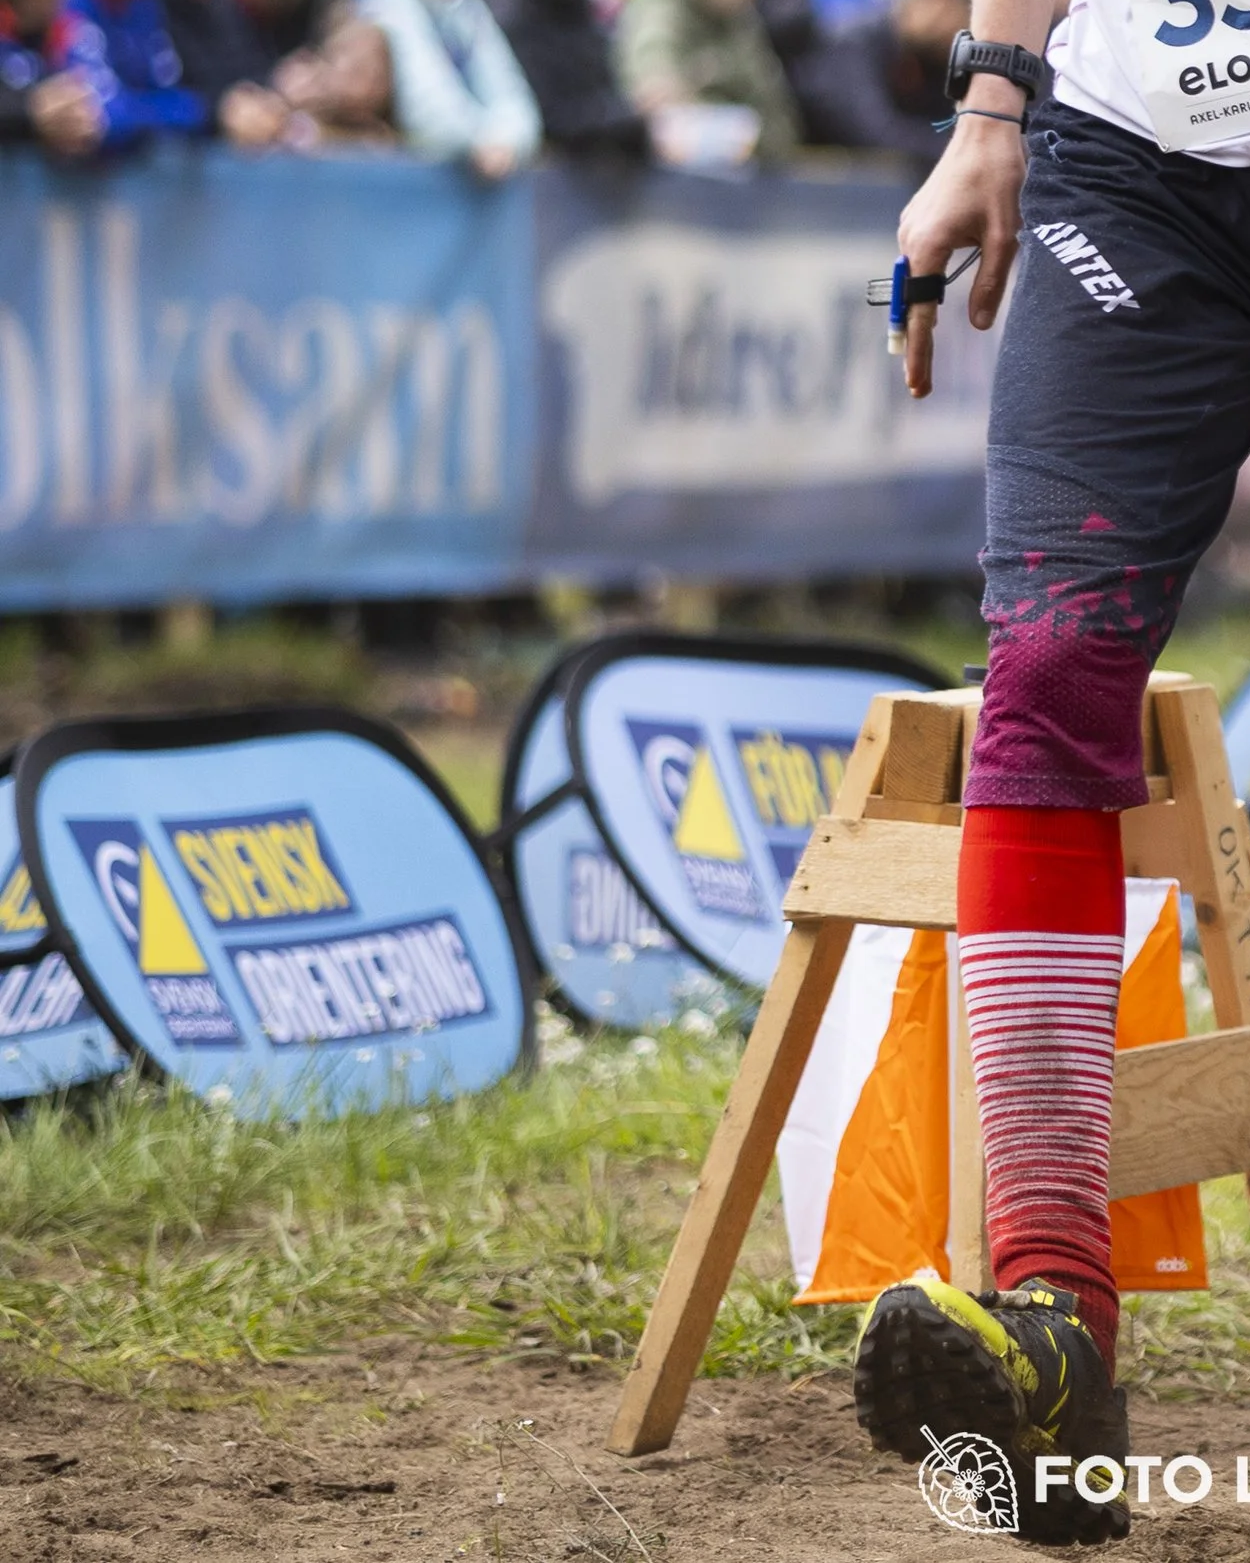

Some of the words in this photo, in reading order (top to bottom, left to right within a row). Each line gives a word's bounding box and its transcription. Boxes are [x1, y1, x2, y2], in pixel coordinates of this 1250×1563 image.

[174, 817, 350, 923] SVENSK
[1216, 825, 1246, 904] OK
[234, 918, 486, 1045] ORIENTERING
